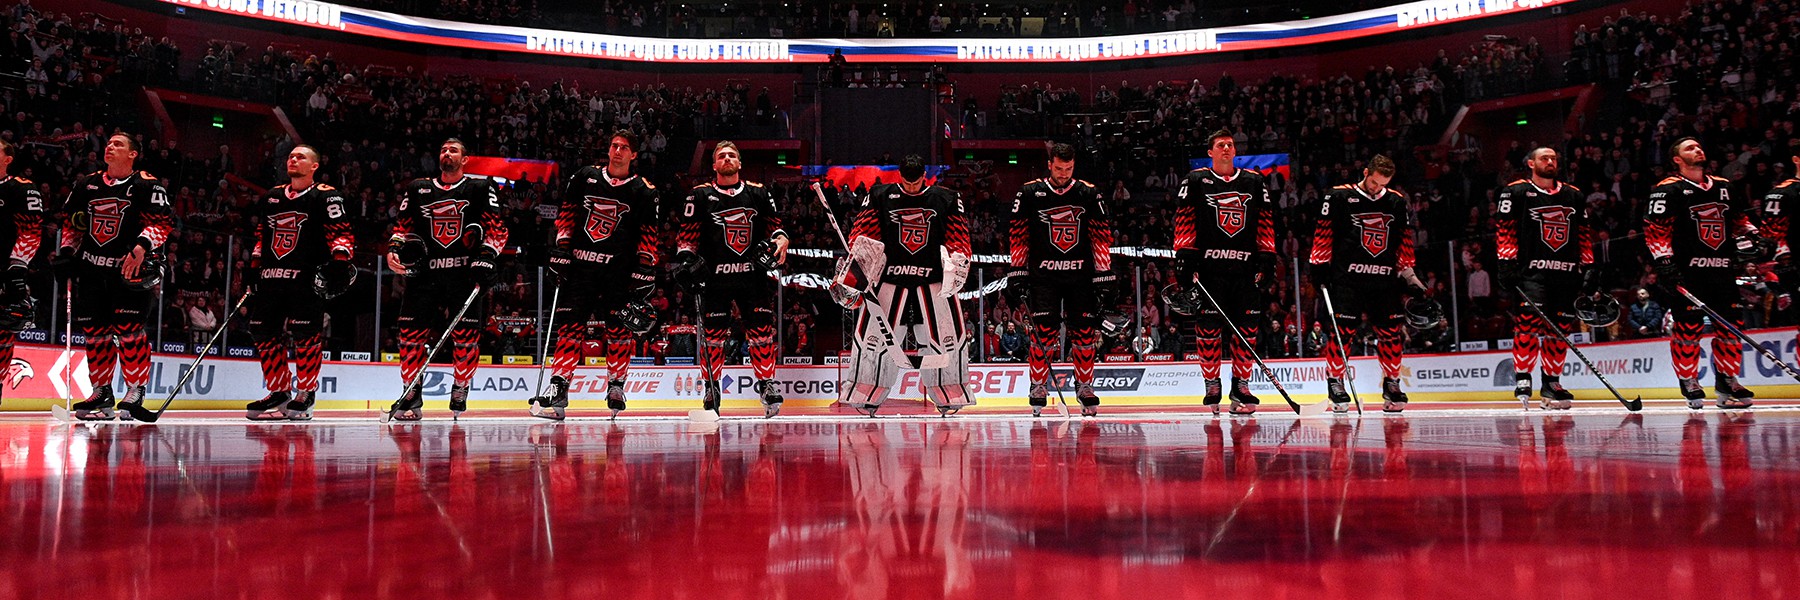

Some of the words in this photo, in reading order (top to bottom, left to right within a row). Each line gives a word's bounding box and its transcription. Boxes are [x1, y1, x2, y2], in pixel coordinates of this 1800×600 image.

[527, 33, 602, 55] БРАТСКИХ
[606, 40, 674, 61] НАРОДОВ
[677, 42, 719, 60] СОЮЗ
[722, 40, 794, 61] ВЕКОВОЙ,
[957, 42, 1030, 60] БРАТСКИХ
[1032, 40, 1100, 61] НАРОДОВ
[1103, 37, 1146, 58] СОЮЗ
[1148, 29, 1222, 55] ВЕКОВОЙ,
[126, 185, 133, 197] C
[1178, 185, 1188, 199] 4
[1720, 188, 1730, 200] A
[1011, 199, 1021, 213] 3
[1321, 202, 1330, 216] 8
[590, 216, 612, 236] 75
[1220, 211, 1242, 227] 75
[94, 219, 116, 235] 75
[436, 222, 458, 237] 75
[1545, 226, 1565, 241] 75
[1701, 224, 1721, 240] 75
[276, 233, 295, 249] 75
[728, 229, 748, 245] 75
[903, 228, 925, 244] 75
[1053, 227, 1075, 243] 75
[1365, 232, 1384, 247] 75
[1204, 249, 1251, 261] FONBET
[1689, 257, 1730, 268] FONBE
[886, 265, 933, 278] FONBET
[1039, 259, 1084, 271] FONBET
[1347, 263, 1393, 276] FONBET
[1529, 259, 1576, 272] FONBET
[343, 353, 369, 361] KHL.RU
[1416, 367, 1490, 380] GISLAVED
[470, 377, 529, 392] LADA
[899, 371, 1024, 395] FBET
